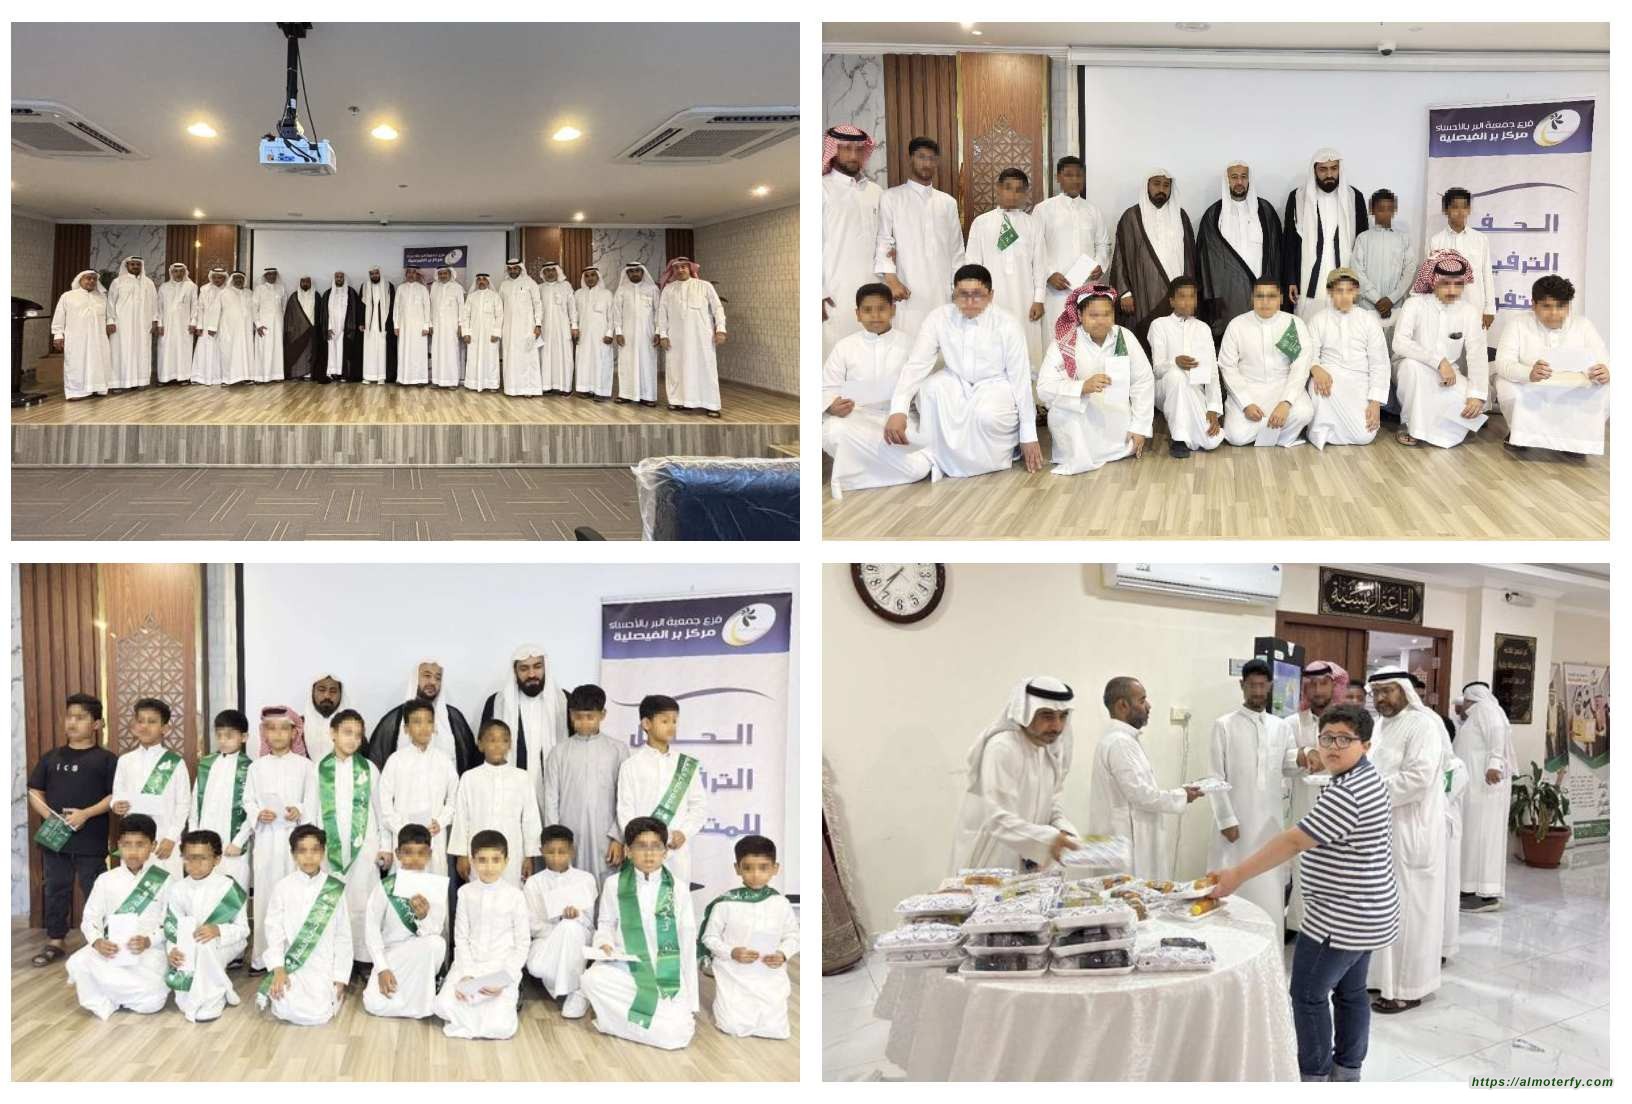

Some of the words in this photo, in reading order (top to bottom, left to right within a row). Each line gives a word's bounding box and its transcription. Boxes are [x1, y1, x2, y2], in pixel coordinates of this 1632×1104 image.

[1485, 121, 1515, 130] جمعية
[1439, 132, 1487, 144] الفيصلية
[1489, 133, 1498, 142] بر
[1501, 131, 1528, 141] مركز
[1471, 213, 1559, 233] الحف
[613, 629, 668, 643] الفيصلية
[672, 630, 682, 640] بر
[685, 628, 716, 639] مركز
